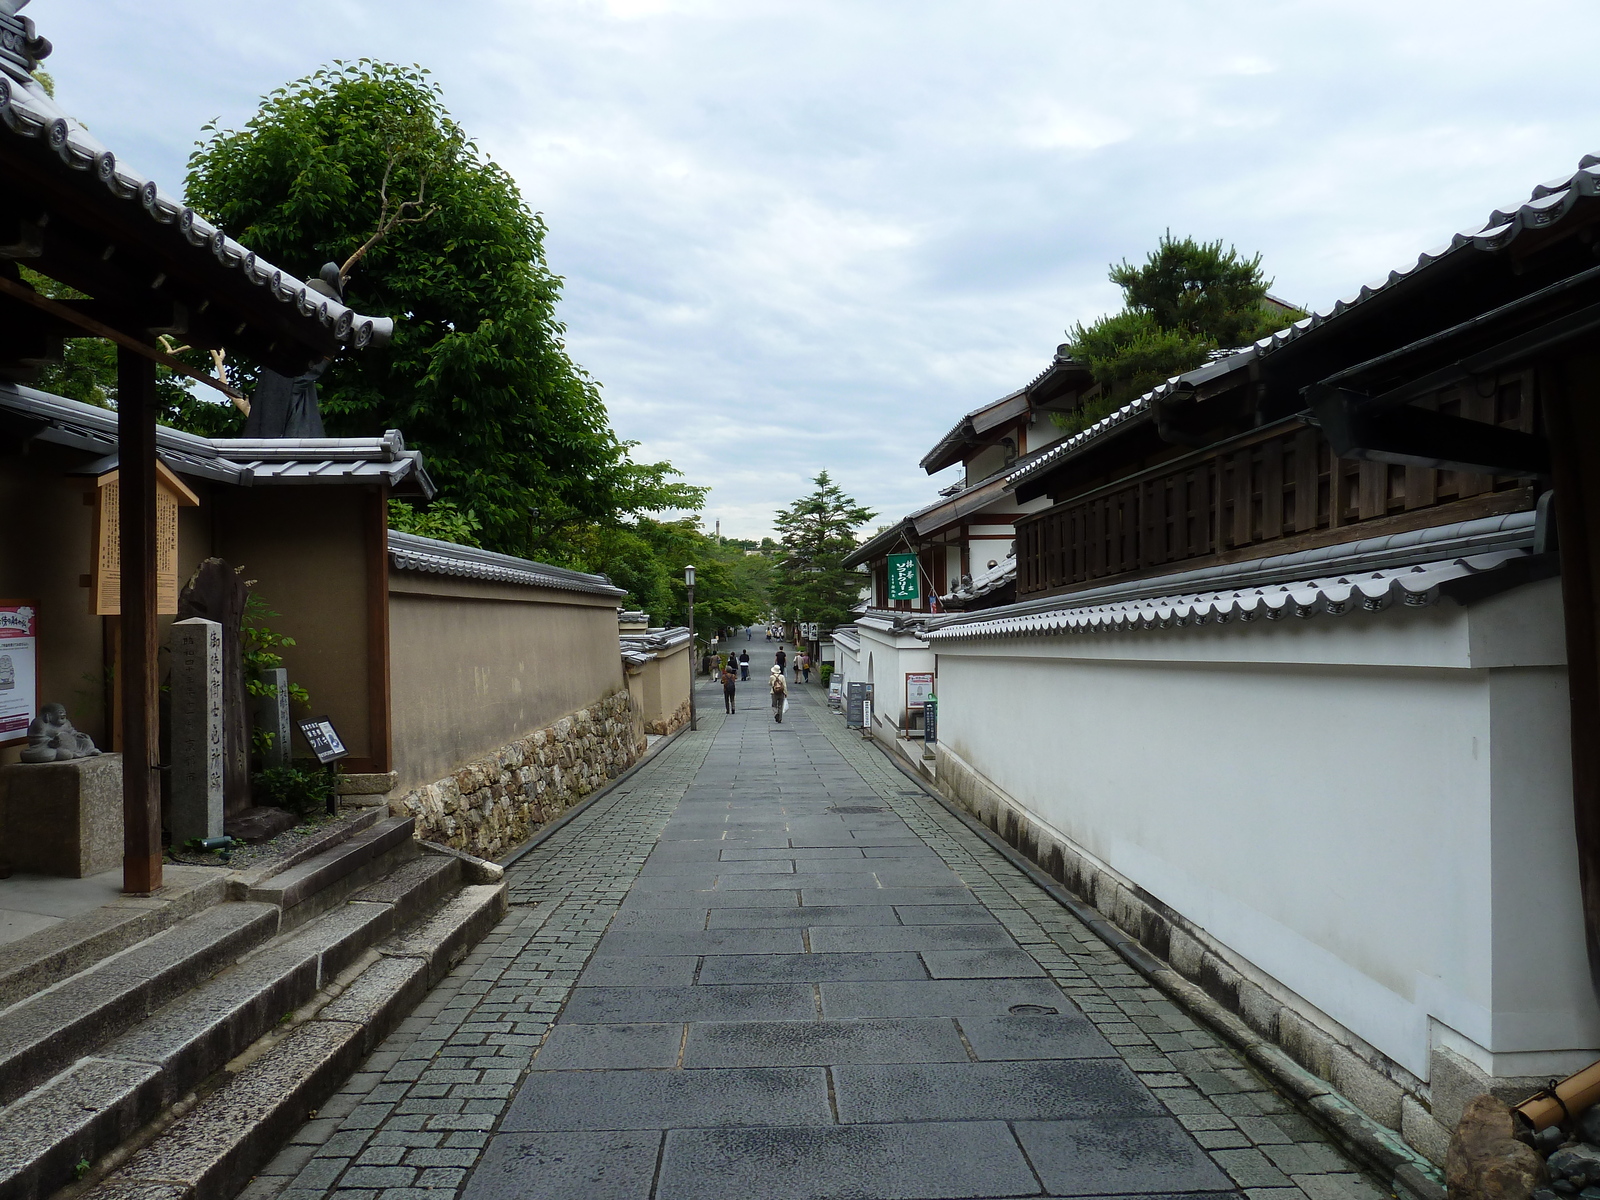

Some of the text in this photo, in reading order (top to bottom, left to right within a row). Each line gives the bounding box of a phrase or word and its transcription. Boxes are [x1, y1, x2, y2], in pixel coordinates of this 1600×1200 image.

[896, 563, 909, 596] ソフトクリーム
